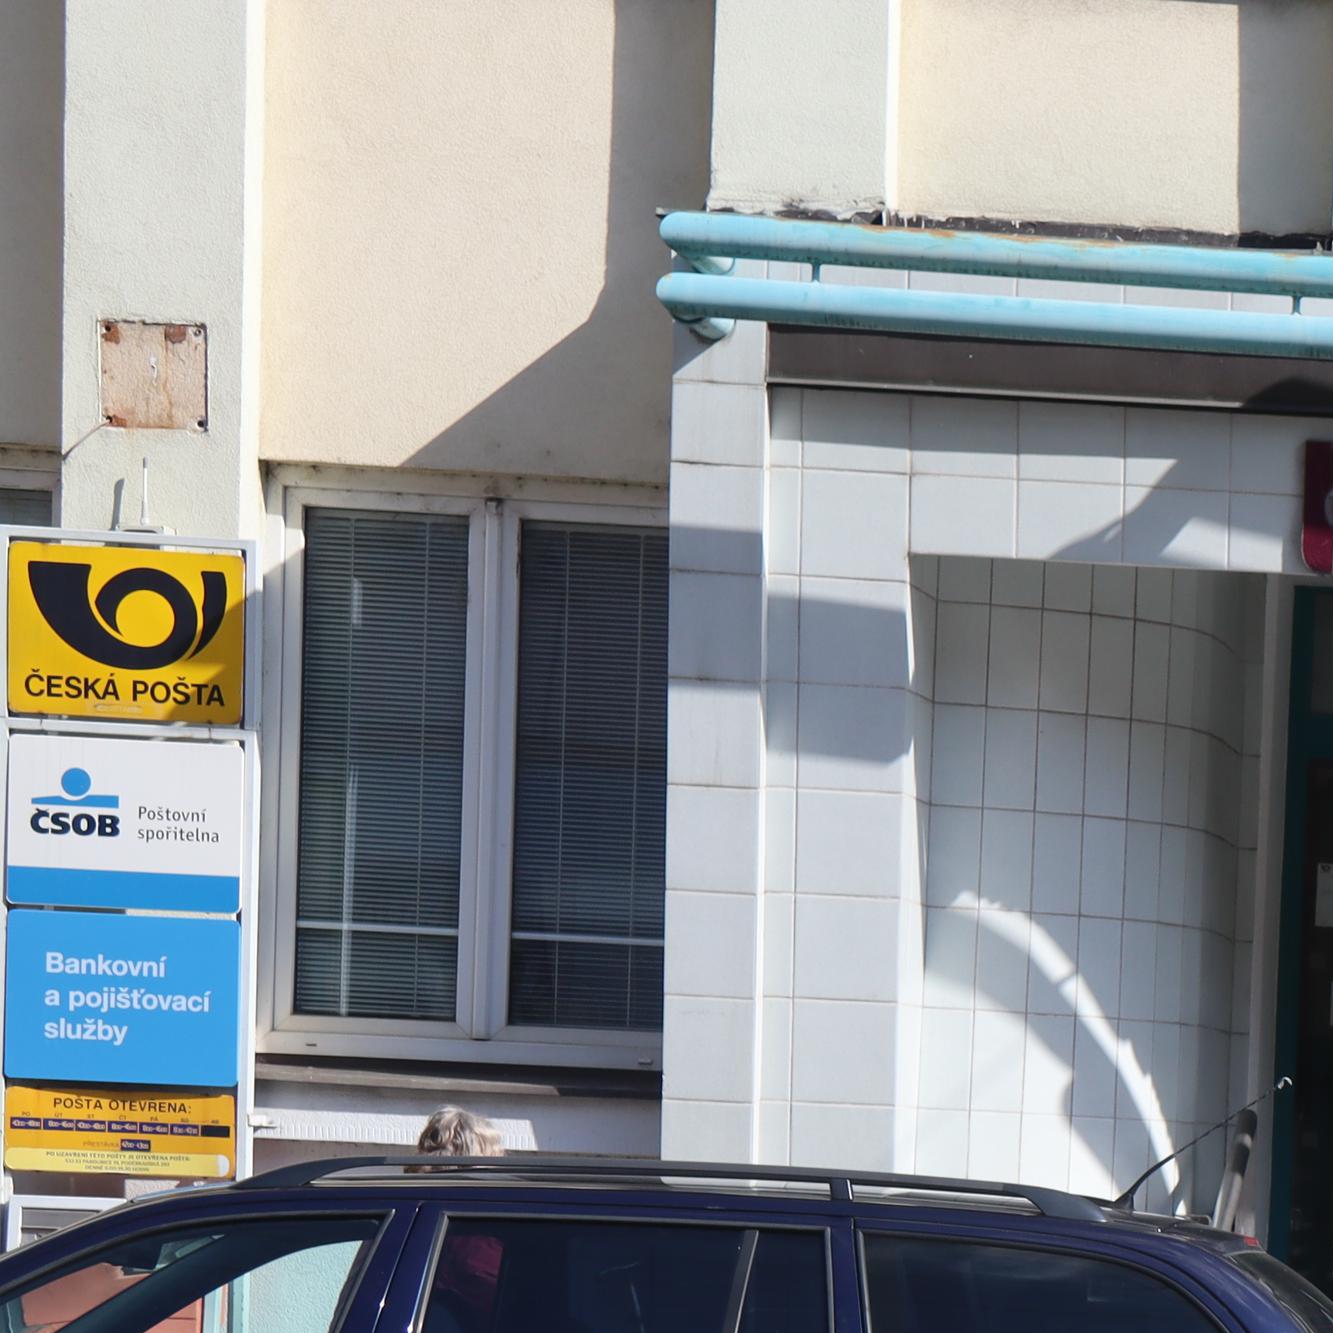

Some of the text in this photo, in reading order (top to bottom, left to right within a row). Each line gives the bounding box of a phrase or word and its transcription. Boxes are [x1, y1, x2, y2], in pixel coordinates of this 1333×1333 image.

[24, 668, 225, 706] ČESKÁ POŠTA
[30, 807, 121, 837] ČSOB
[138, 805, 207, 823] Poštovní
[137, 826, 219, 843] spořitelna
[45, 951, 168, 978] Bankovní
[44, 986, 212, 1013] a pojišťovací
[44, 1017, 129, 1046] služby
